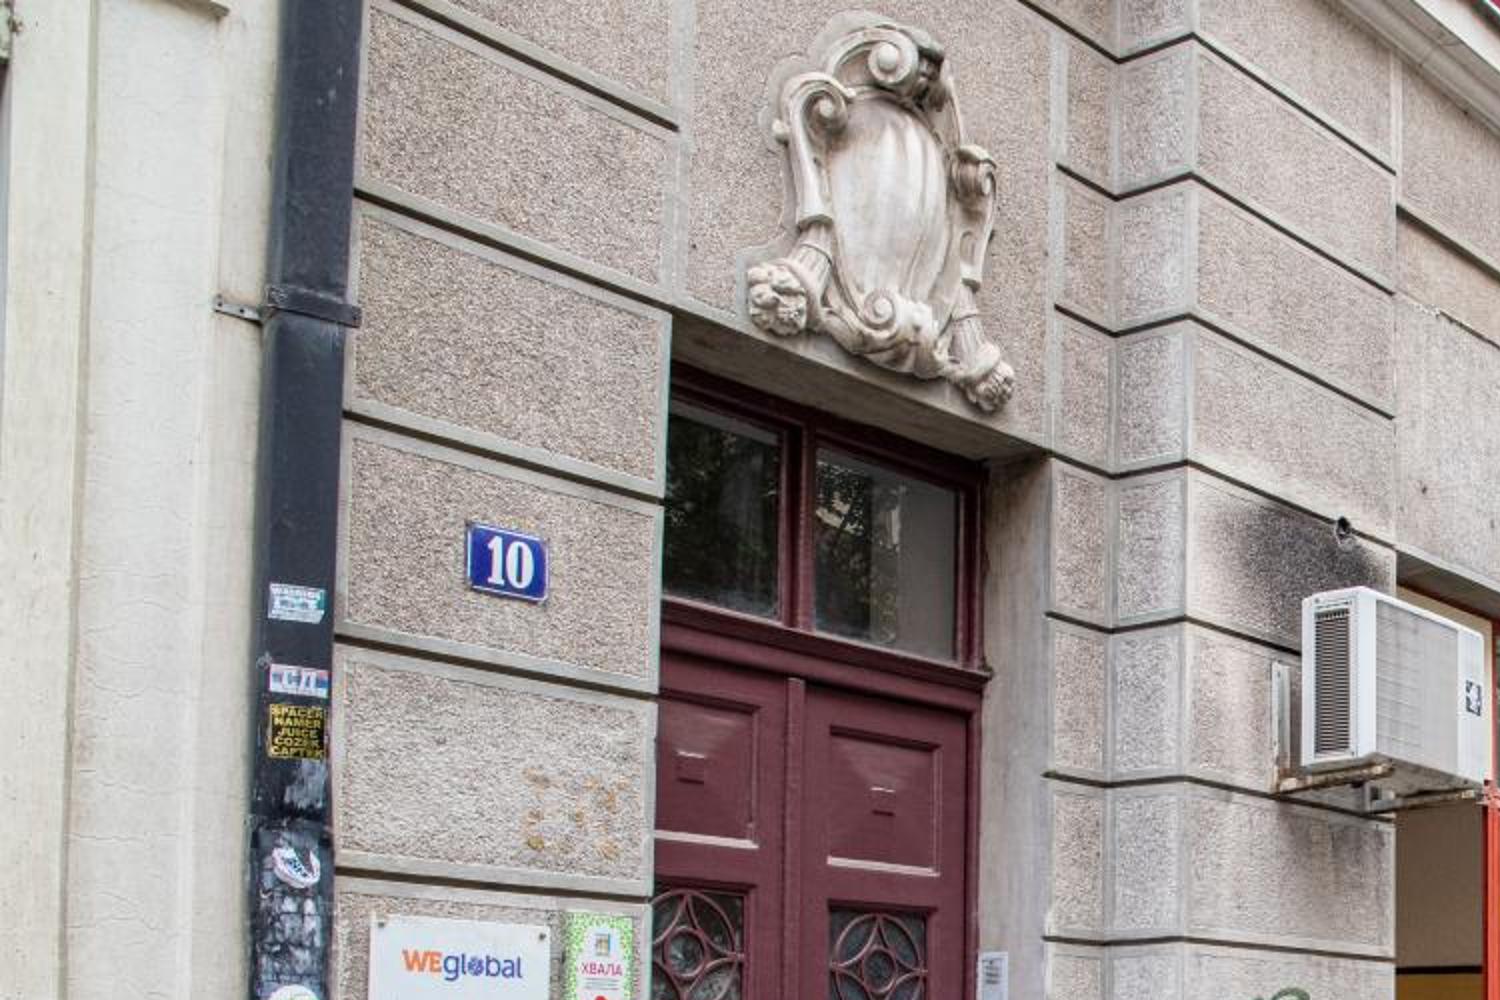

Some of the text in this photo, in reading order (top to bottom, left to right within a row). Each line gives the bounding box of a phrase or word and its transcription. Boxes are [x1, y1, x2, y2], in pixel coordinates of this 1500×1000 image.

[487, 535, 535, 589] 10
[402, 949, 523, 981] WEglobal
[581, 961, 623, 977] ХВАЛА
